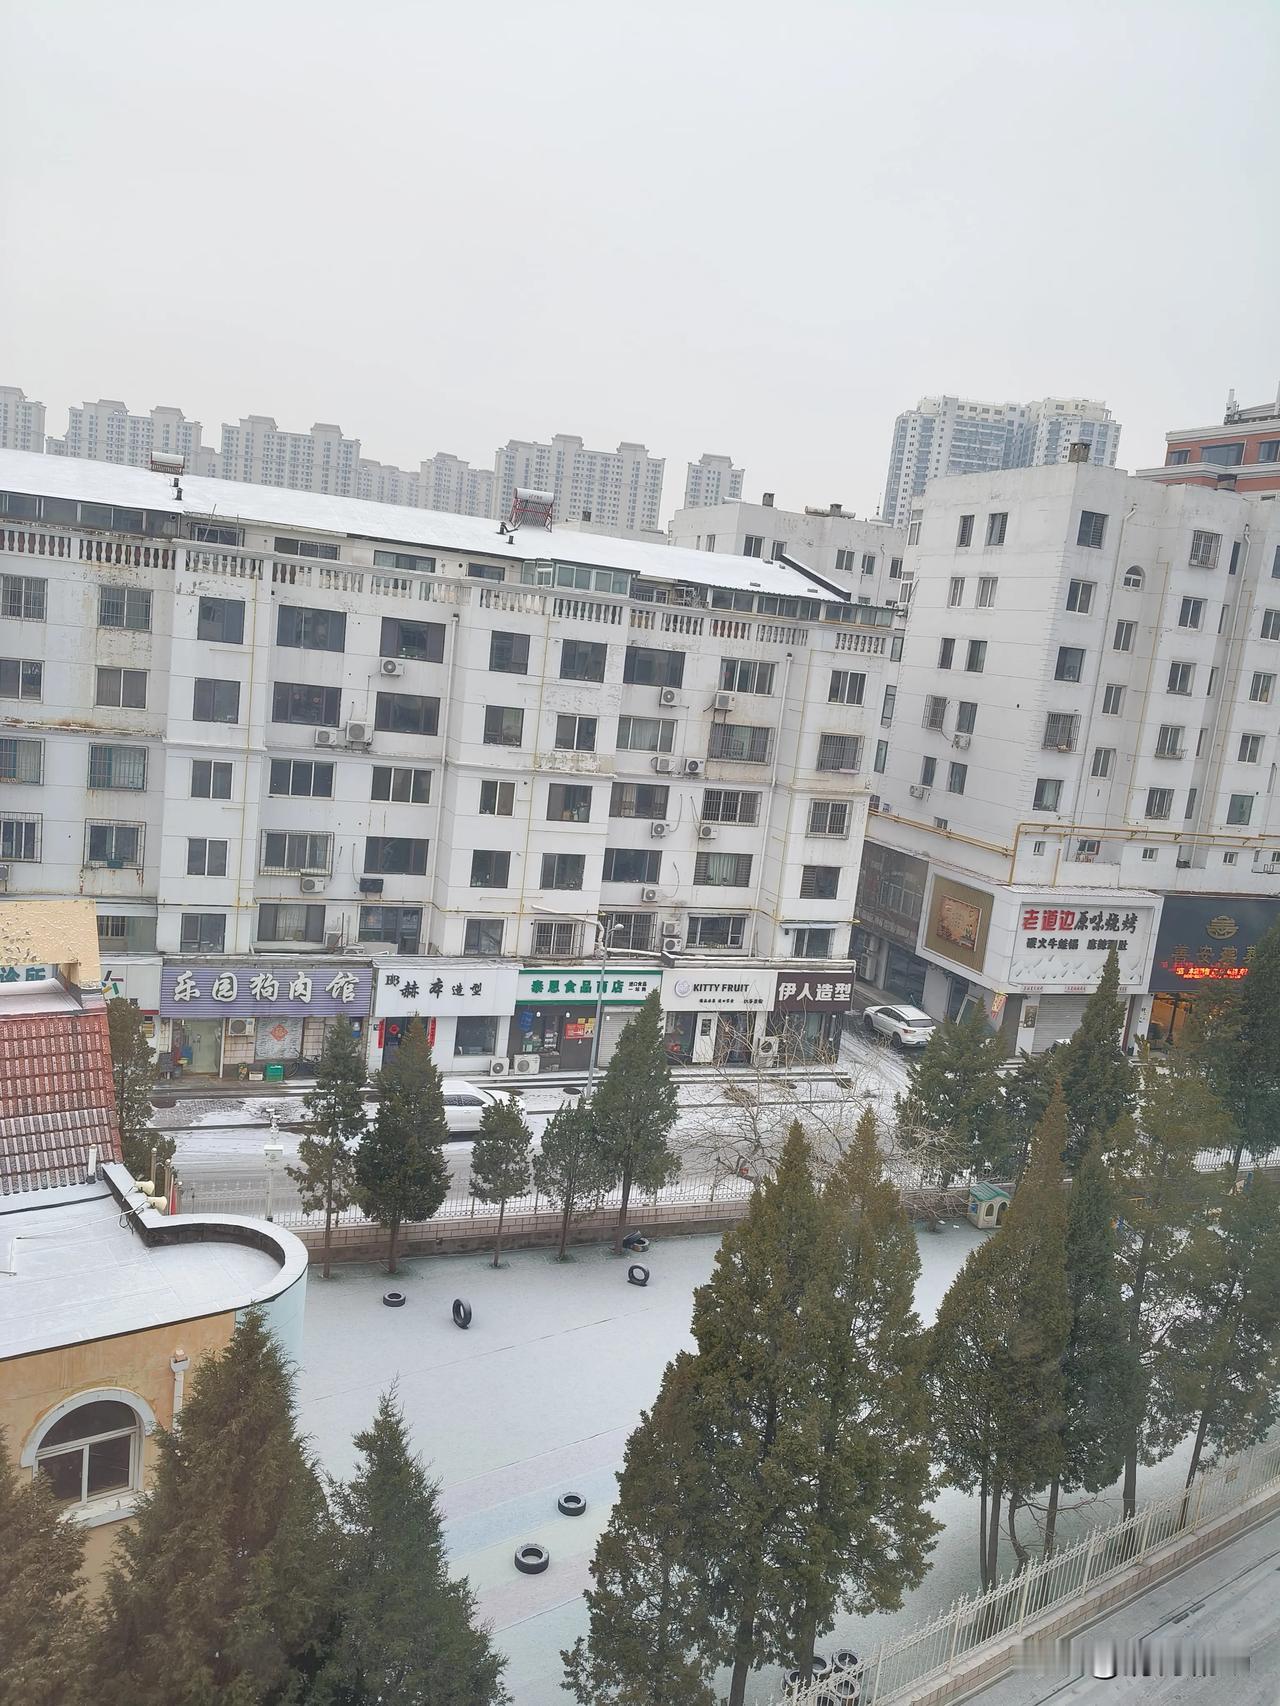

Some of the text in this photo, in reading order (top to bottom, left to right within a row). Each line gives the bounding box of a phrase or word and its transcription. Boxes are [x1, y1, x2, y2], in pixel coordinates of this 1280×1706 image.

[173, 970, 360, 1004] 乐园狗肉馆
[693, 984, 749, 992] KITTY FRUIT
[778, 982, 852, 1001] 伊人造型
